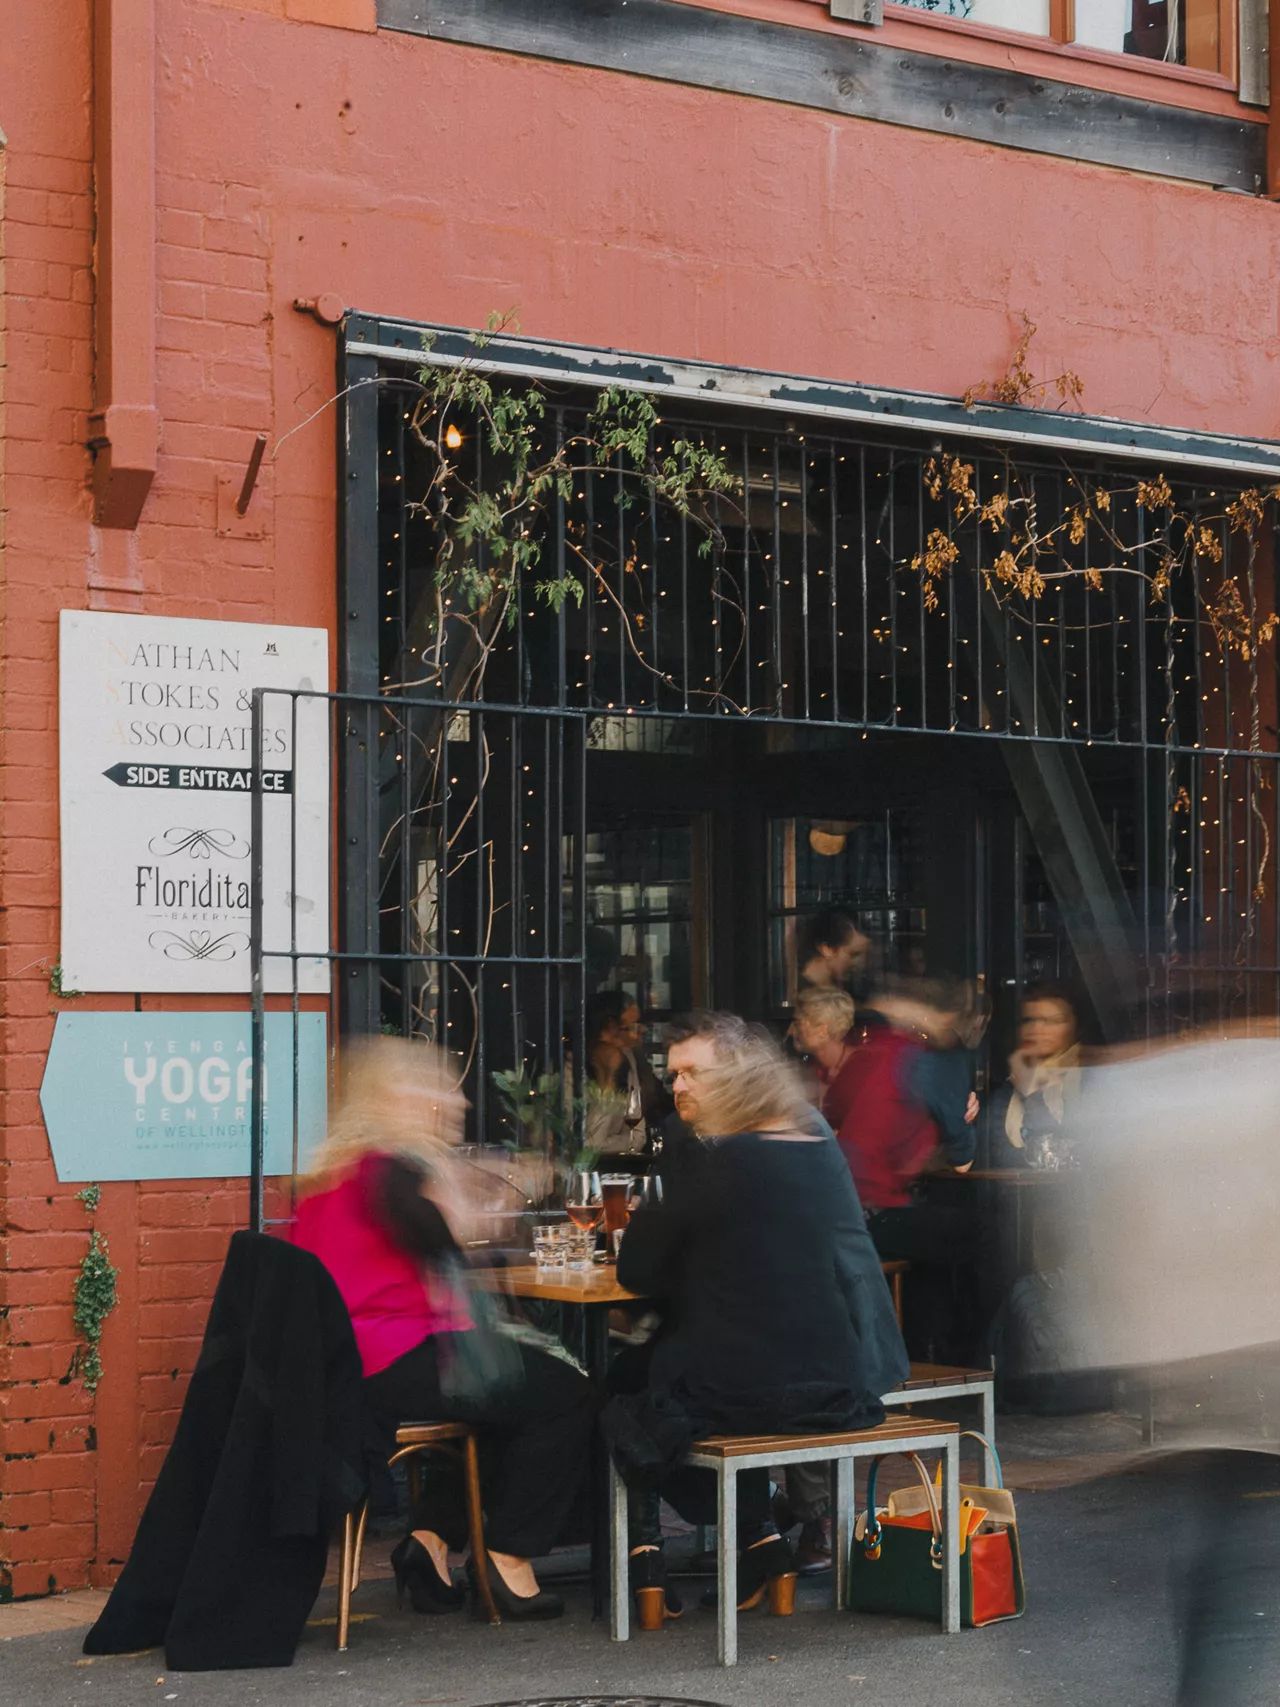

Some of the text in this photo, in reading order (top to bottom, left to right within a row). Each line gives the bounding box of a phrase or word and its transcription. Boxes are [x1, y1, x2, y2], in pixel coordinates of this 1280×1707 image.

[236, 688, 253, 712] &
[126, 766, 170, 785] SIDE
[171, 912, 229, 921] BAKERY
[123, 1057, 268, 1104] YOGA
[136, 1124, 269, 1138] OF WELLINGTN
